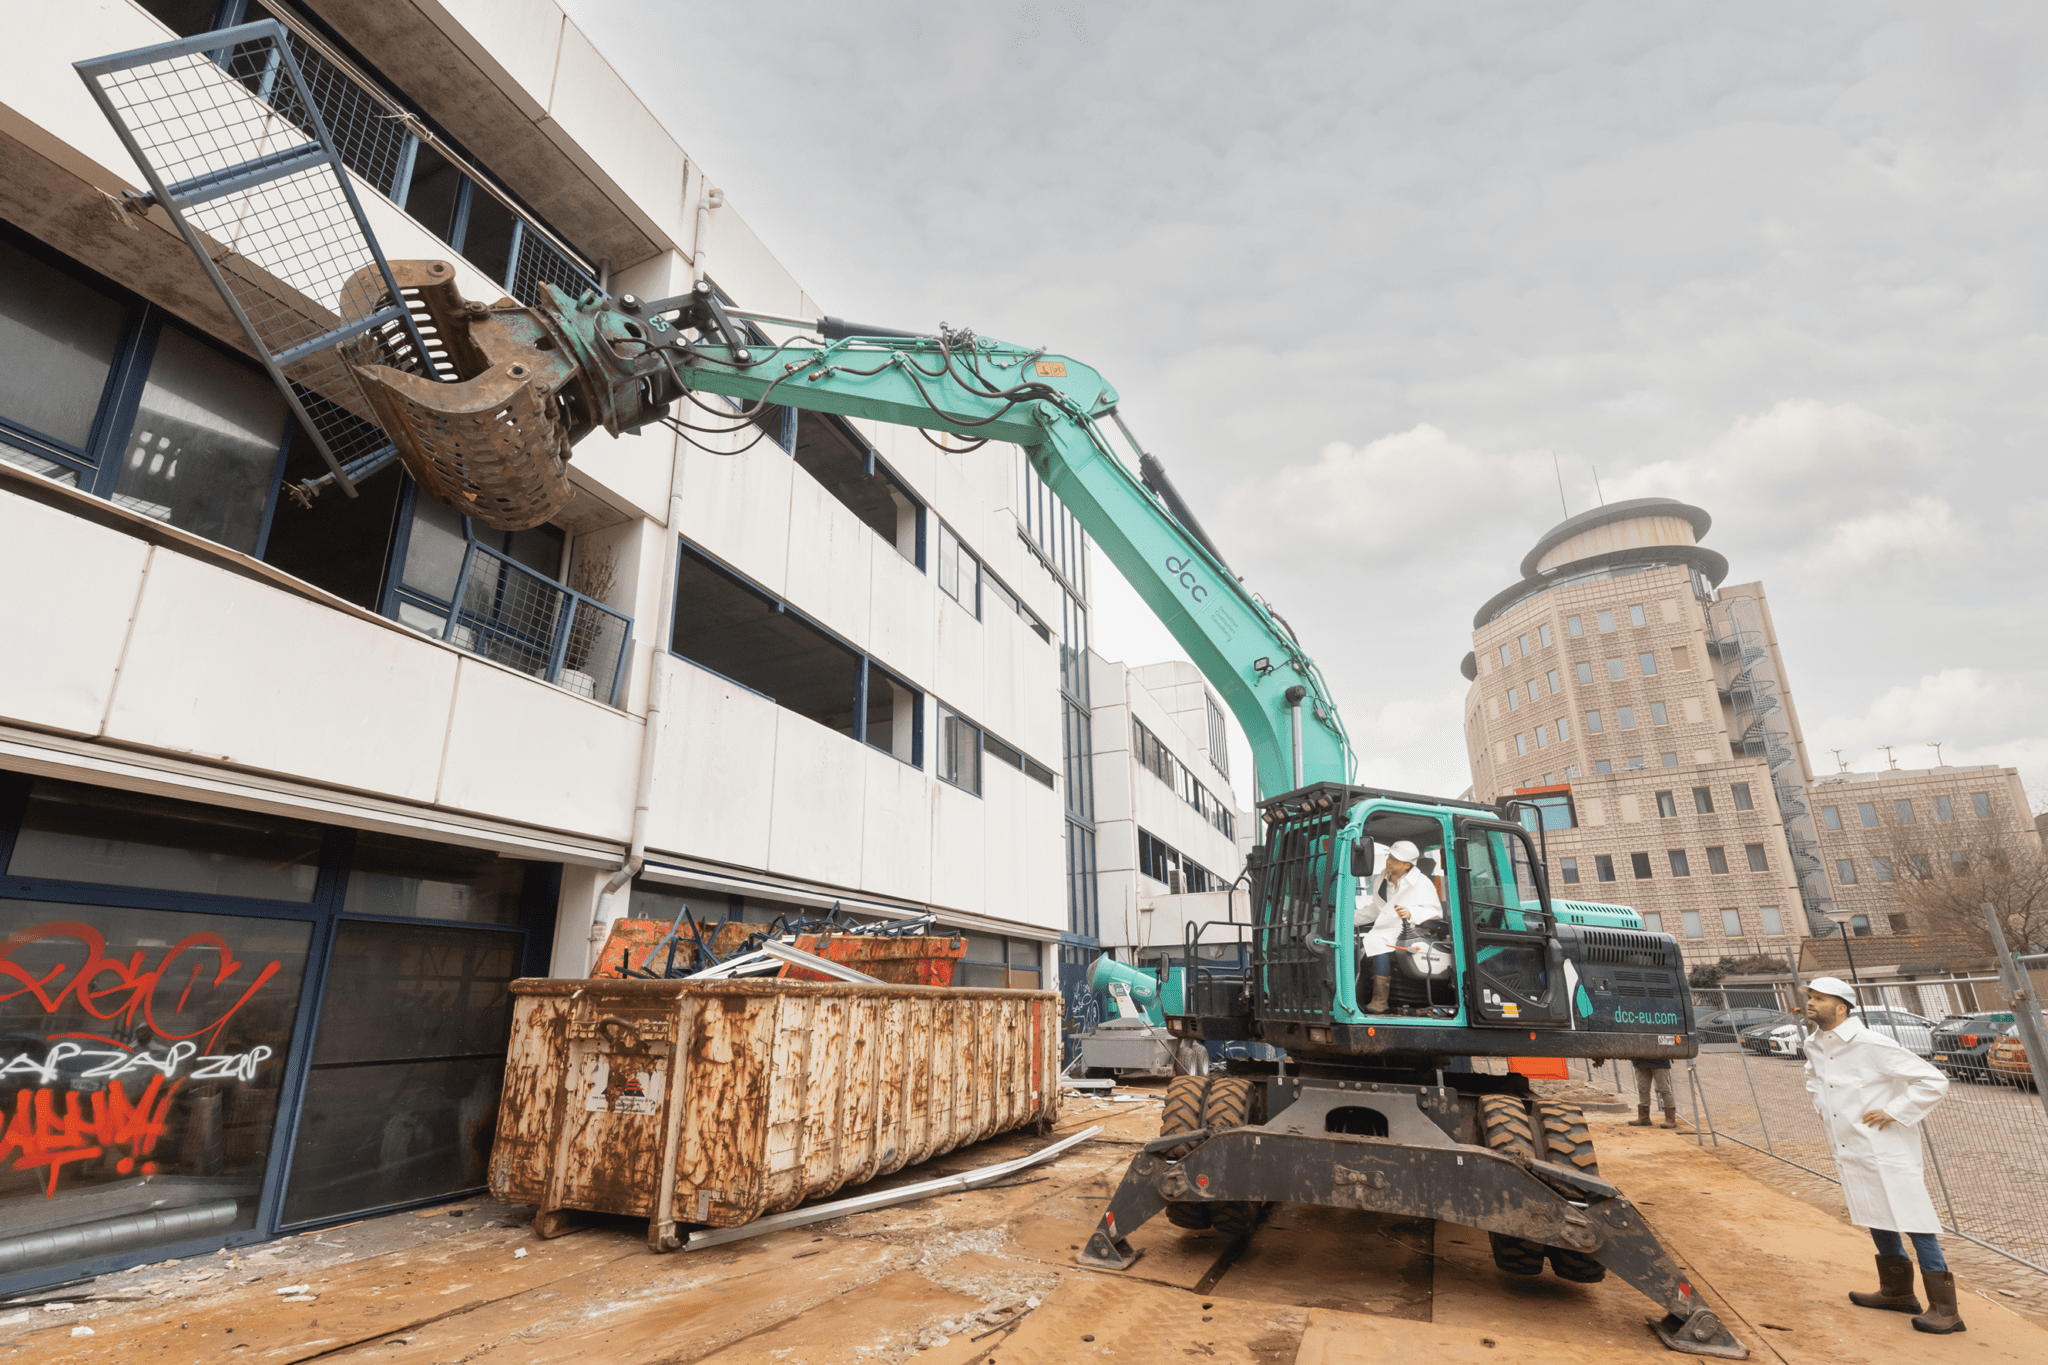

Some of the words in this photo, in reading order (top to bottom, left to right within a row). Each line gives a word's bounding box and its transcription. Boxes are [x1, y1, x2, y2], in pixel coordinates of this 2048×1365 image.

[1165, 556, 1208, 603] dcc
[1614, 1005, 1678, 1025] dcc-eu.com
[80, 1041, 197, 1078] ZAP
